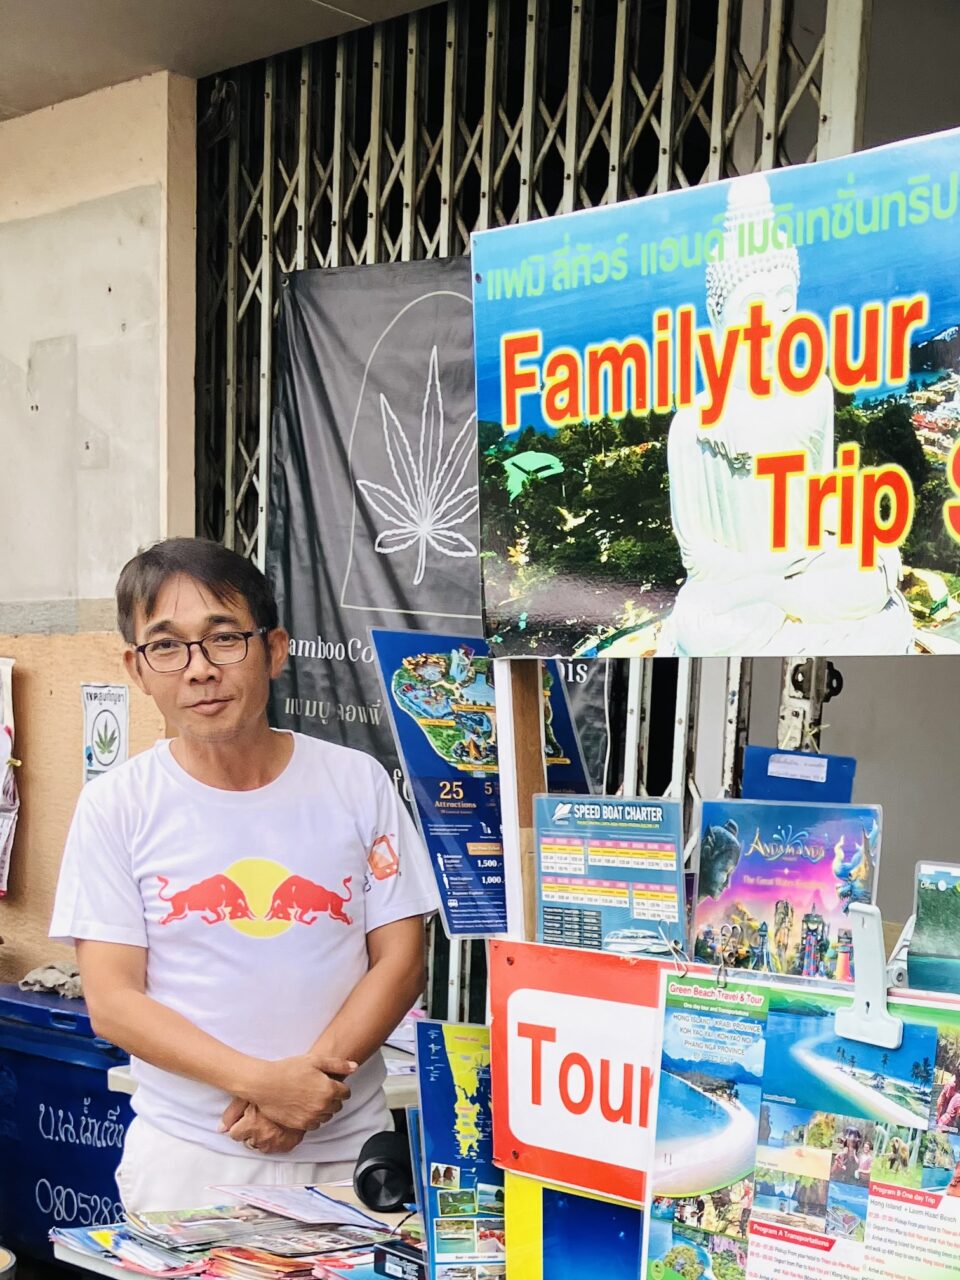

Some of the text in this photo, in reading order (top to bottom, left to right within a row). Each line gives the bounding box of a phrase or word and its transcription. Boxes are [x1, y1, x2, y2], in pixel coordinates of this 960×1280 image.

[501, 293, 927, 433] Familytour
[755, 443, 914, 571] Trip
[288, 635, 345, 660] amboo
[439, 781, 493, 799] 25 5
[434, 800, 477, 809] Attractions
[574, 804, 662, 821] SPEED BOAT CHARTER
[670, 984, 762, 1005] Green Beach Travel & Tour
[517, 1021, 654, 1128] Tour
[36, 1178, 125, 1227] 0805288
